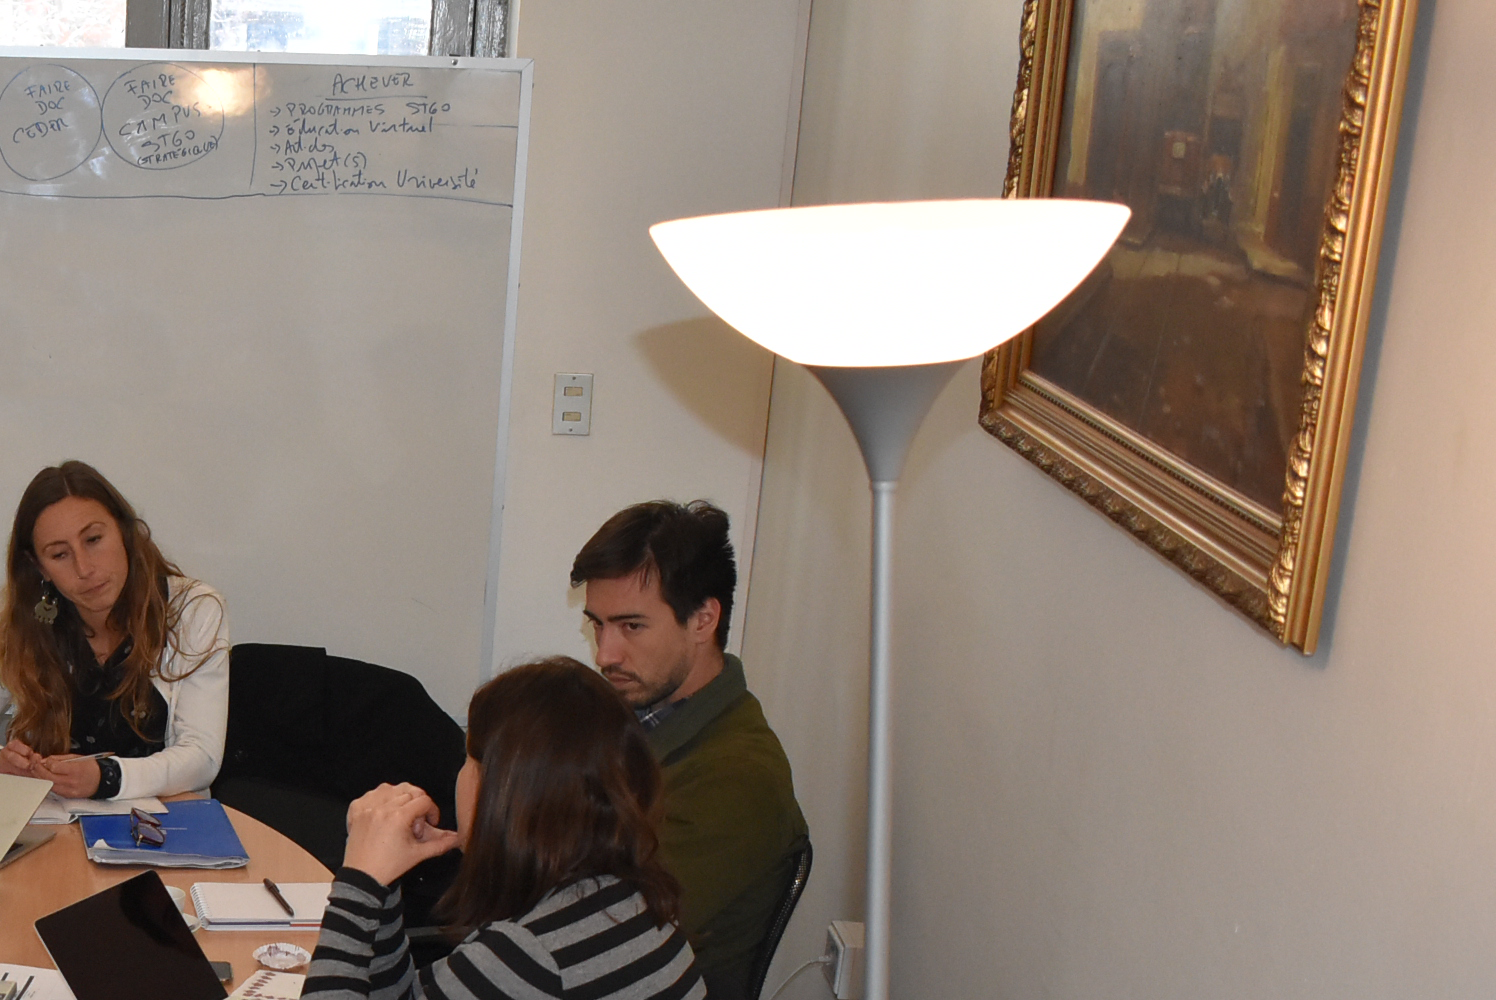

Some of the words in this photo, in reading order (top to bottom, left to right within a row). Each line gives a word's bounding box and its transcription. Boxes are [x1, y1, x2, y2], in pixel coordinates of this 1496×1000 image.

[23, 80, 71, 99] FAIRE
[123, 73, 176, 95] FAIRE
[331, 72, 414, 96] ACHEVER
[34, 96, 65, 116] DOC
[137, 89, 173, 110] DOC
[286, 102, 385, 117] PROGRAMMES
[118, 101, 202, 136] CAMPUS
